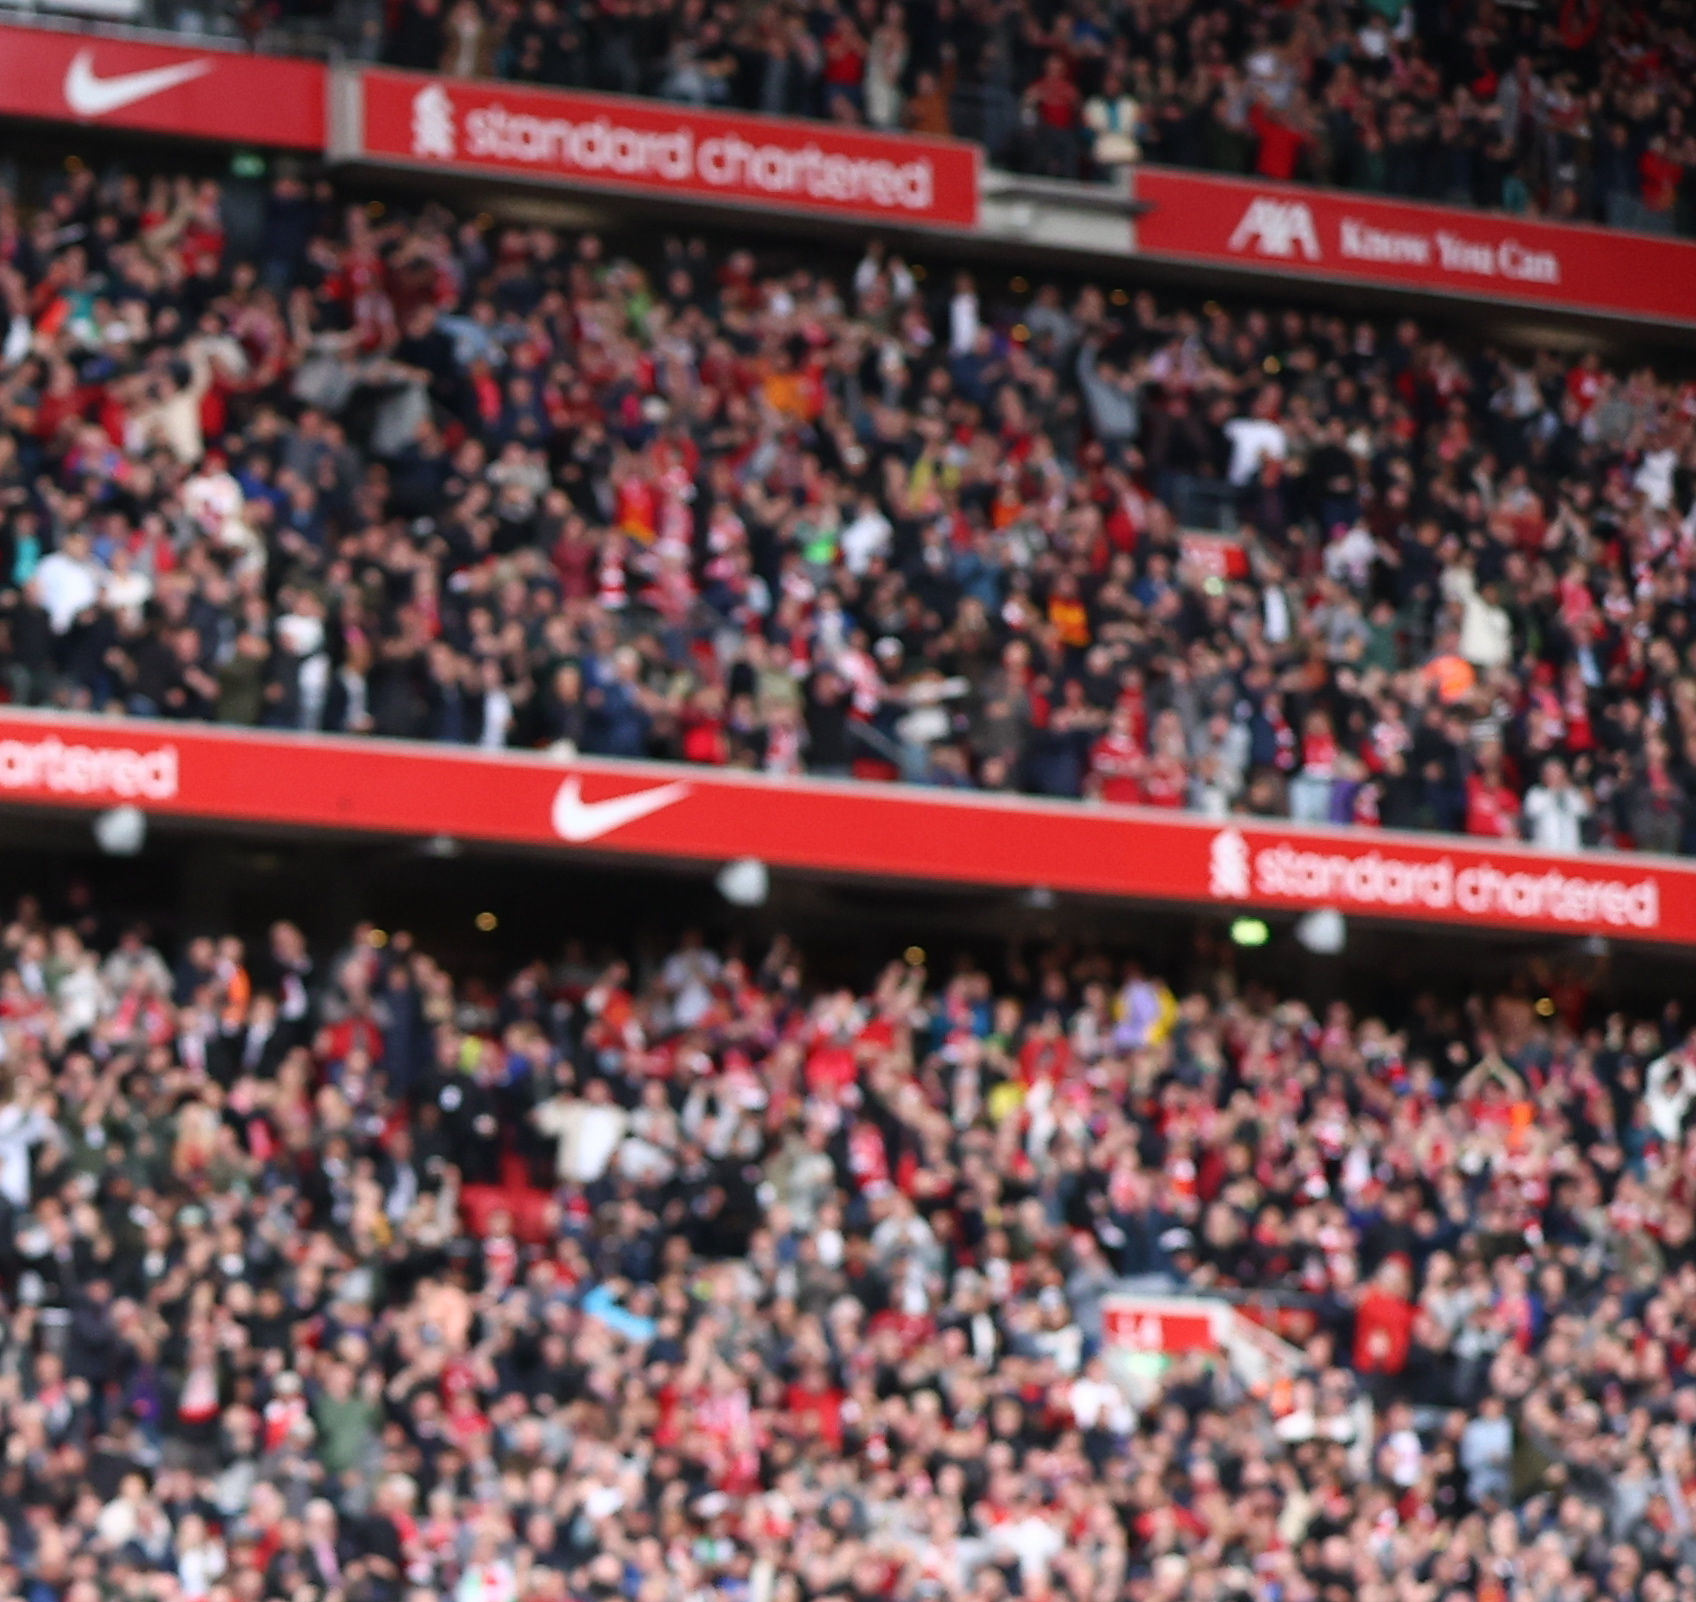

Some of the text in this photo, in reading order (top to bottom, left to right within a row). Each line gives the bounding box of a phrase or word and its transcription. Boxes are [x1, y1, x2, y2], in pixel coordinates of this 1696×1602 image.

[465, 103, 932, 207] standard chartered
[1254, 840, 1660, 928] standard chartered
